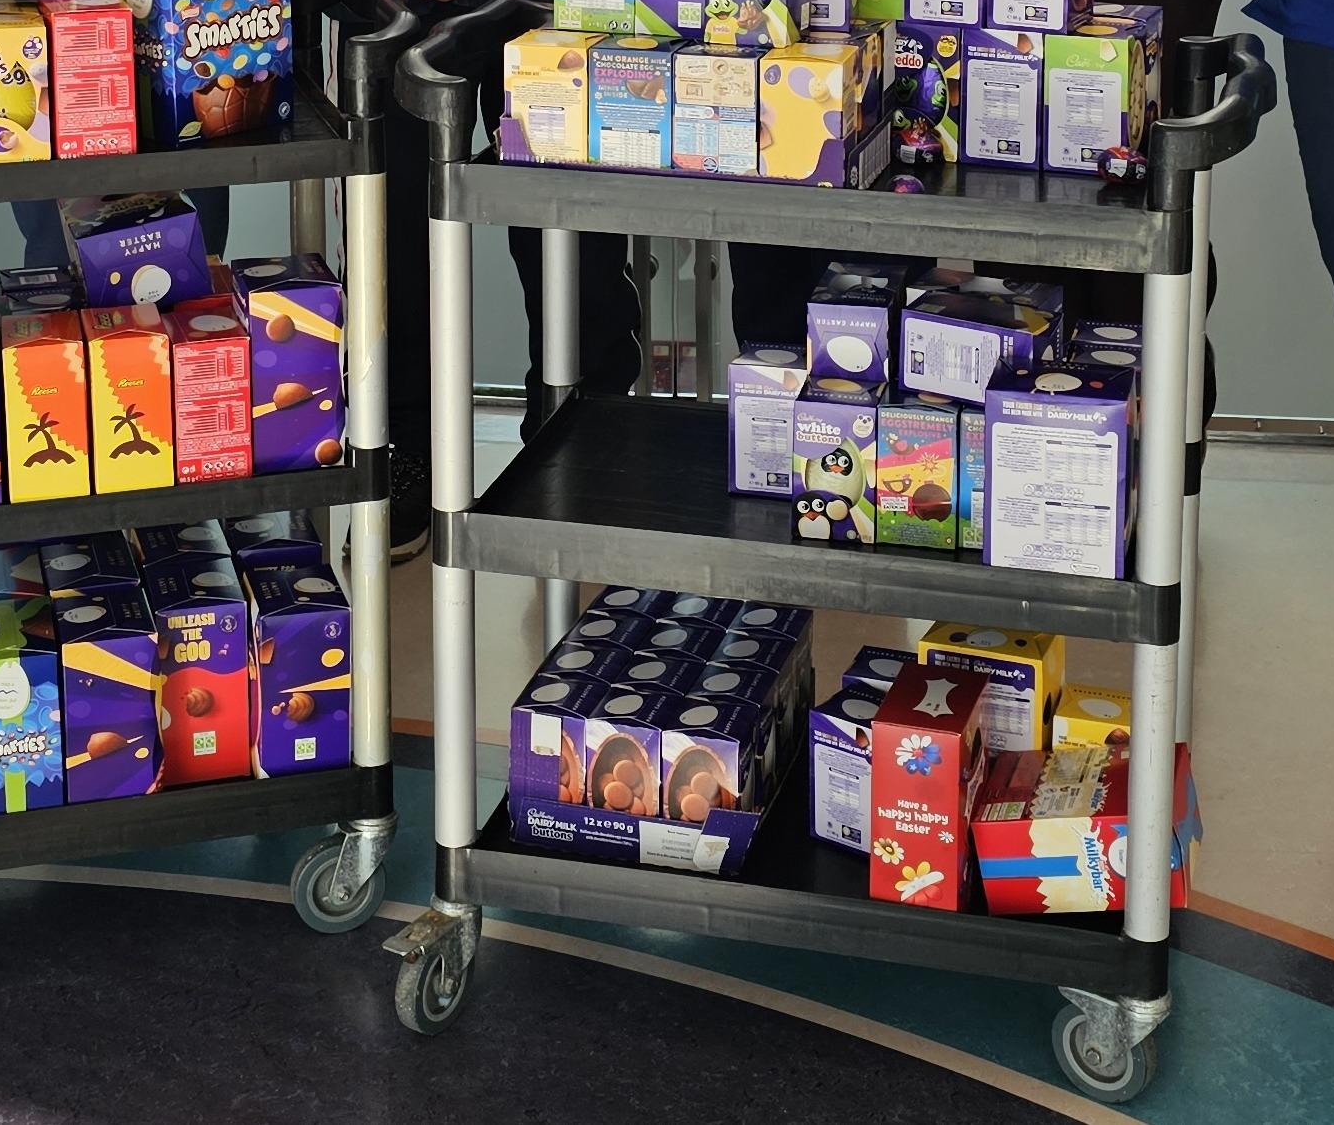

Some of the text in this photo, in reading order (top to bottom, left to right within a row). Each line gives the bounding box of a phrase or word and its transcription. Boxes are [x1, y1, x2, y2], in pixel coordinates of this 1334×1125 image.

[185, 4, 283, 59] SMARTIES
[595, 61, 638, 70] CHOCOLATE
[600, 54, 613, 62] AN
[614, 55, 649, 64] ORANGE
[895, 55, 923, 67] eddo
[595, 68, 654, 80] EXPLODING
[118, 231, 162, 248] EASTER
[124, 241, 162, 256] HAPPY
[880, 411, 955, 424] DELICIOUSLY ORANGE
[1047, 411, 1094, 422] DAIRY MILK
[796, 421, 842, 436] white
[880, 418, 956, 433] EGGSTREMELY
[797, 432, 842, 445] buttons
[167, 612, 216, 629] UNLEASH
[181, 627, 203, 641] THE
[174, 640, 211, 664] GOO
[973, 665, 1014, 679] DAIRY MILK
[897, 799, 928, 812] Have a
[877, 806, 949, 826] happy happy
[527, 817, 578, 832] DAIRY MILK
[584, 816, 634, 834] 12 x 90 g
[895, 820, 931, 835] Easter
[531, 825, 574, 842] buttons
[1083, 835, 1104, 893] Milkybar
